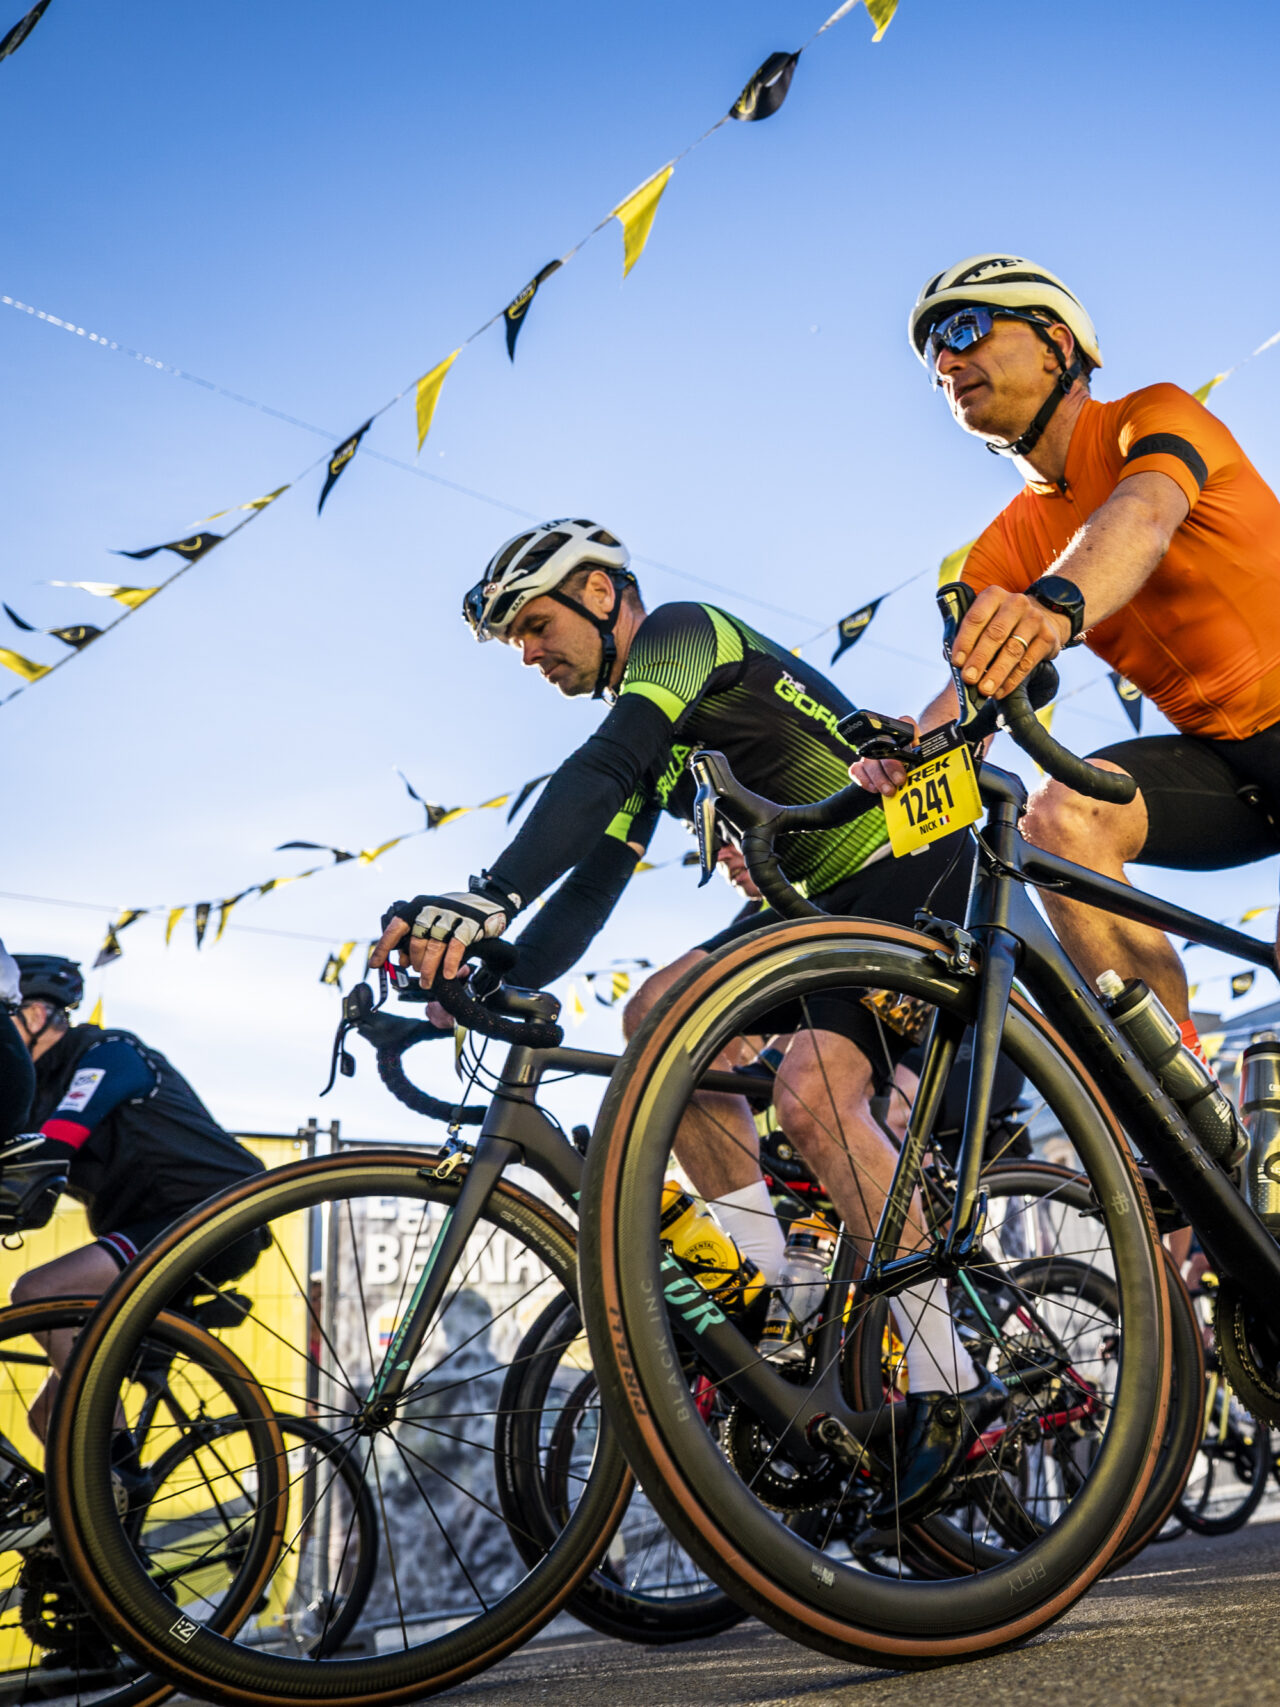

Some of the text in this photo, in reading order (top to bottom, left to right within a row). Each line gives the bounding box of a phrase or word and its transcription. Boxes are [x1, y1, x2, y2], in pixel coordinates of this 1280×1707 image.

[781, 670, 806, 695] THE
[899, 773, 955, 828] 1241
[919, 819, 938, 836] NICK
[608, 1305, 649, 1417] PIRELLI
[640, 1279, 691, 1423] BLACK INC
